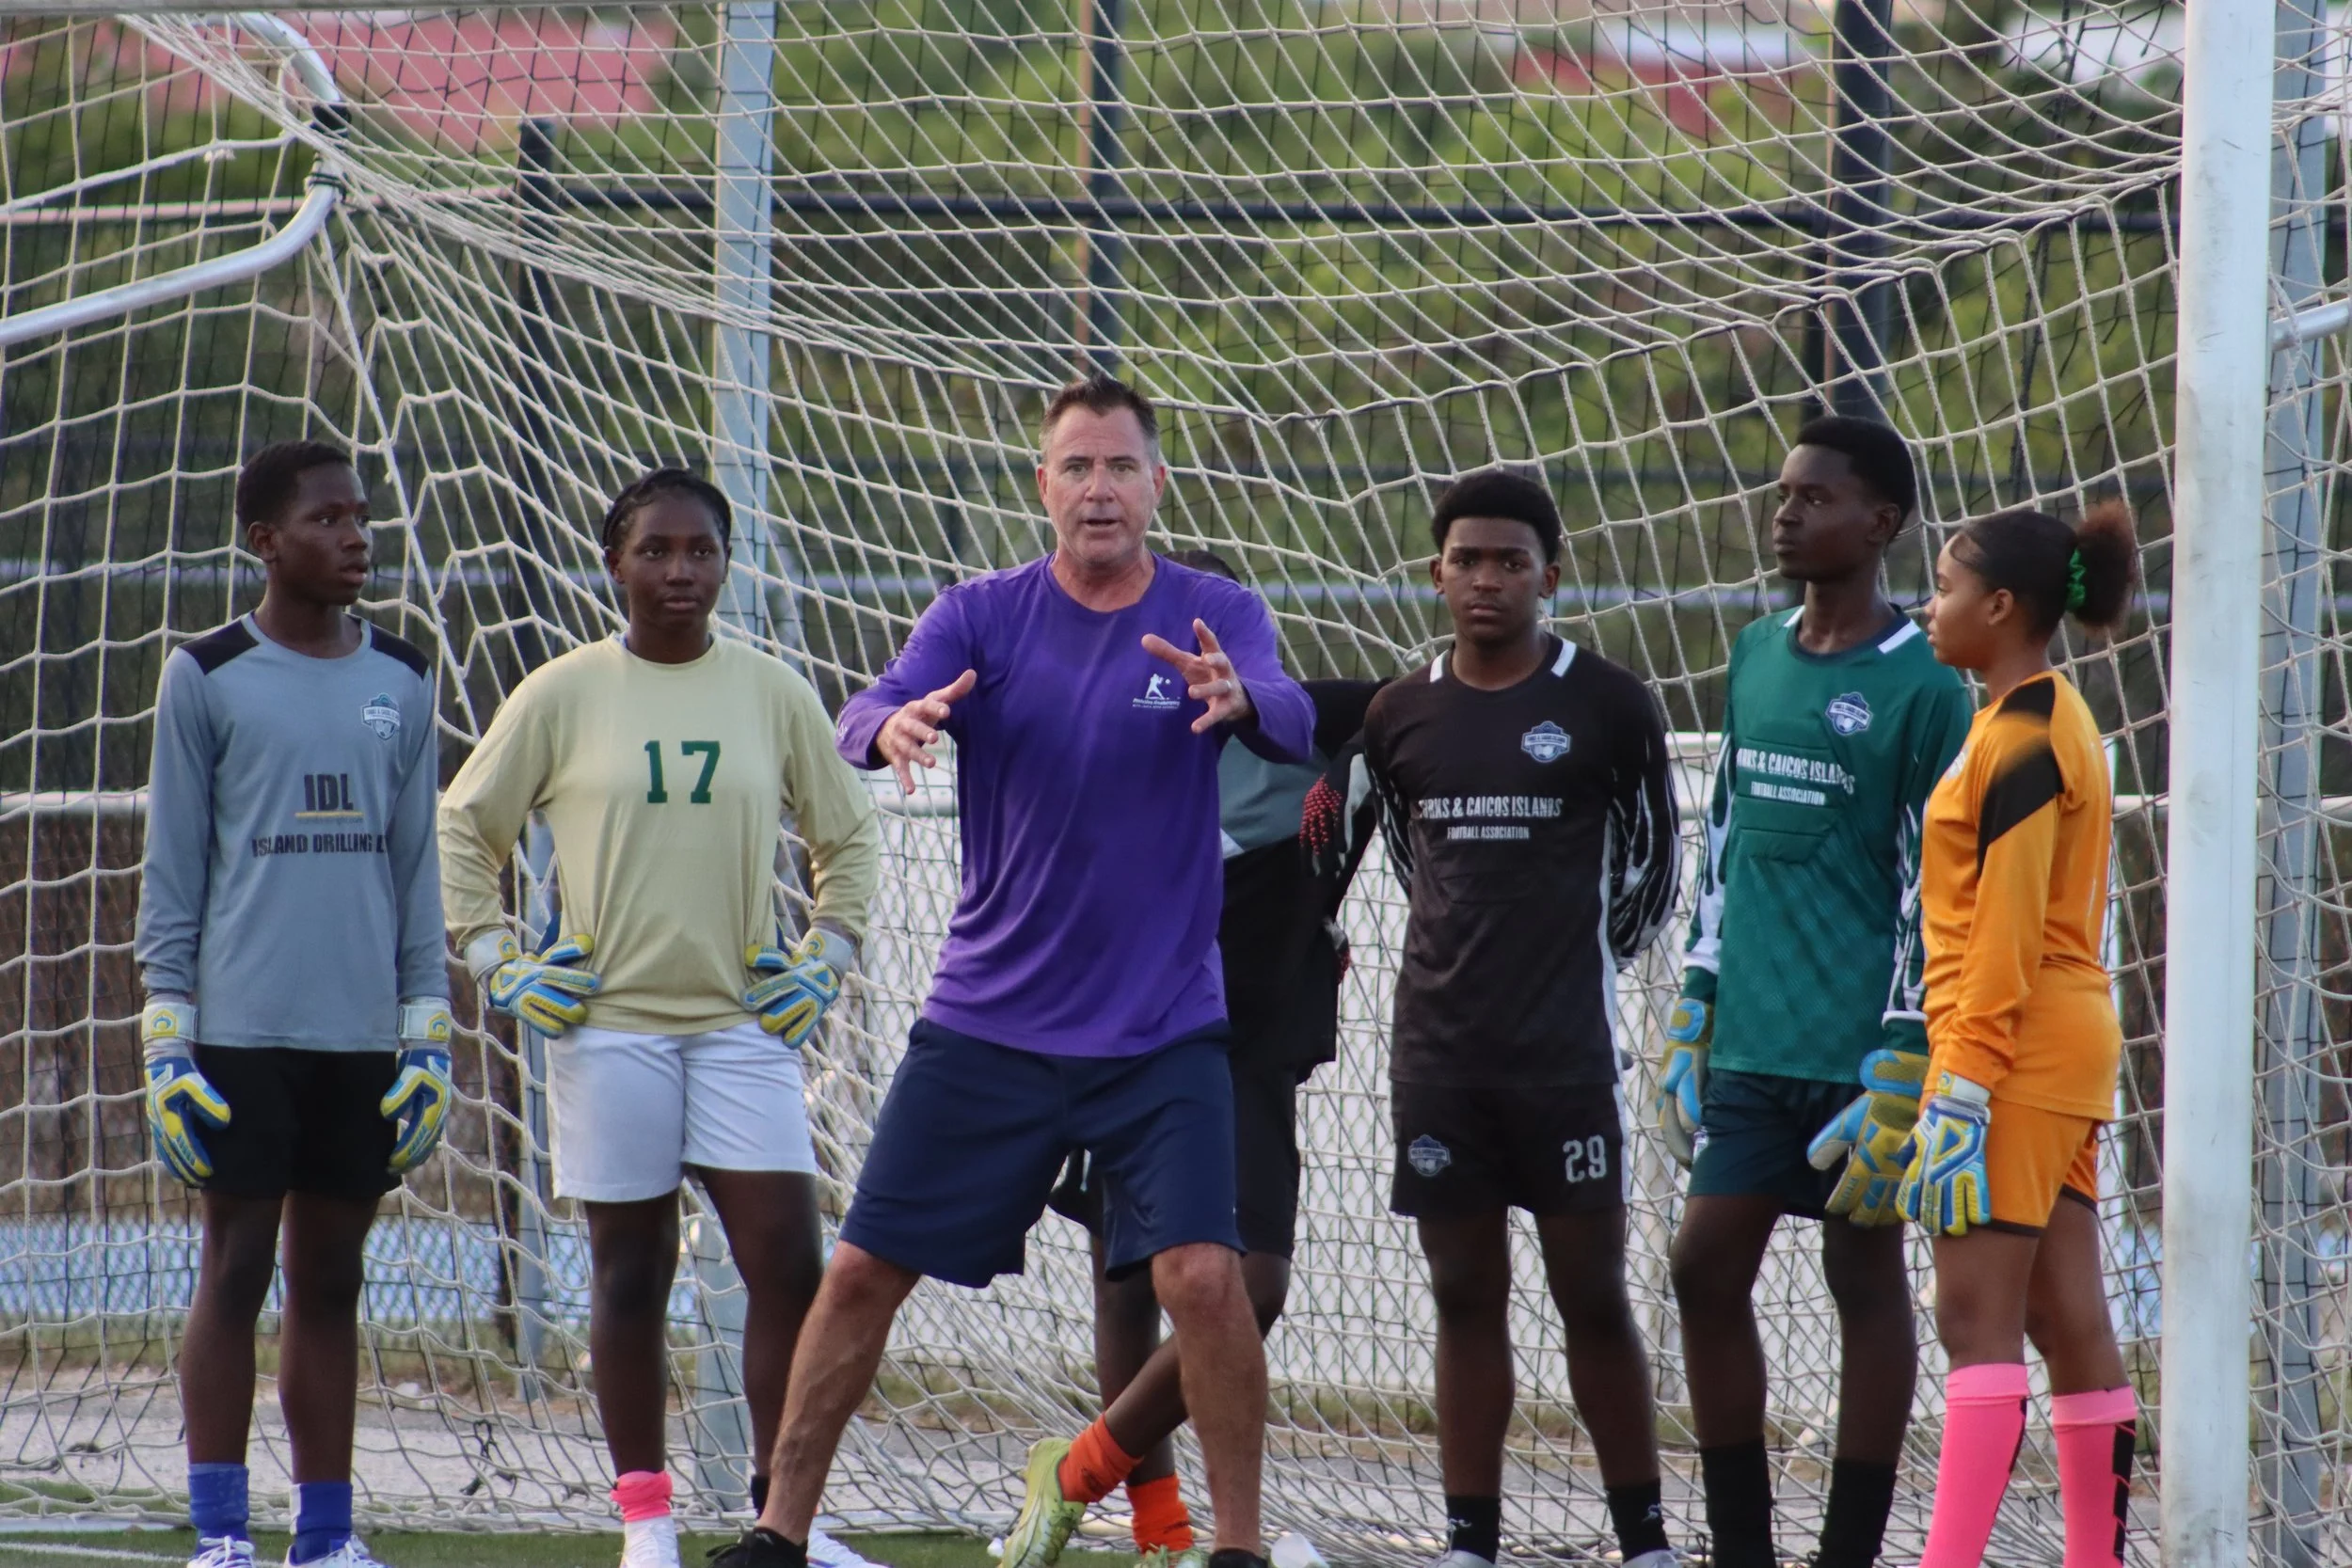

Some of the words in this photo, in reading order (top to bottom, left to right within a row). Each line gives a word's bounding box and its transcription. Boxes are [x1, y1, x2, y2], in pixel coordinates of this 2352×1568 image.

[644, 740, 721, 803] 17
[1757, 751, 1767, 772] &
[1768, 752, 1807, 780] CAICOS
[304, 773, 354, 811] IDL
[1751, 781, 1777, 799] FOOTBALL
[1777, 785, 1825, 806] ASSOCIATION
[1452, 797, 1464, 817] &
[1466, 796, 1509, 817] CAICOS
[1512, 796, 1564, 817] ISLANDS
[251, 833, 309, 858] ISLAND
[1447, 826, 1479, 840] FOOTBALL
[1480, 825, 1530, 840] ASSOCIATION
[1563, 1134, 1607, 1183] 29
